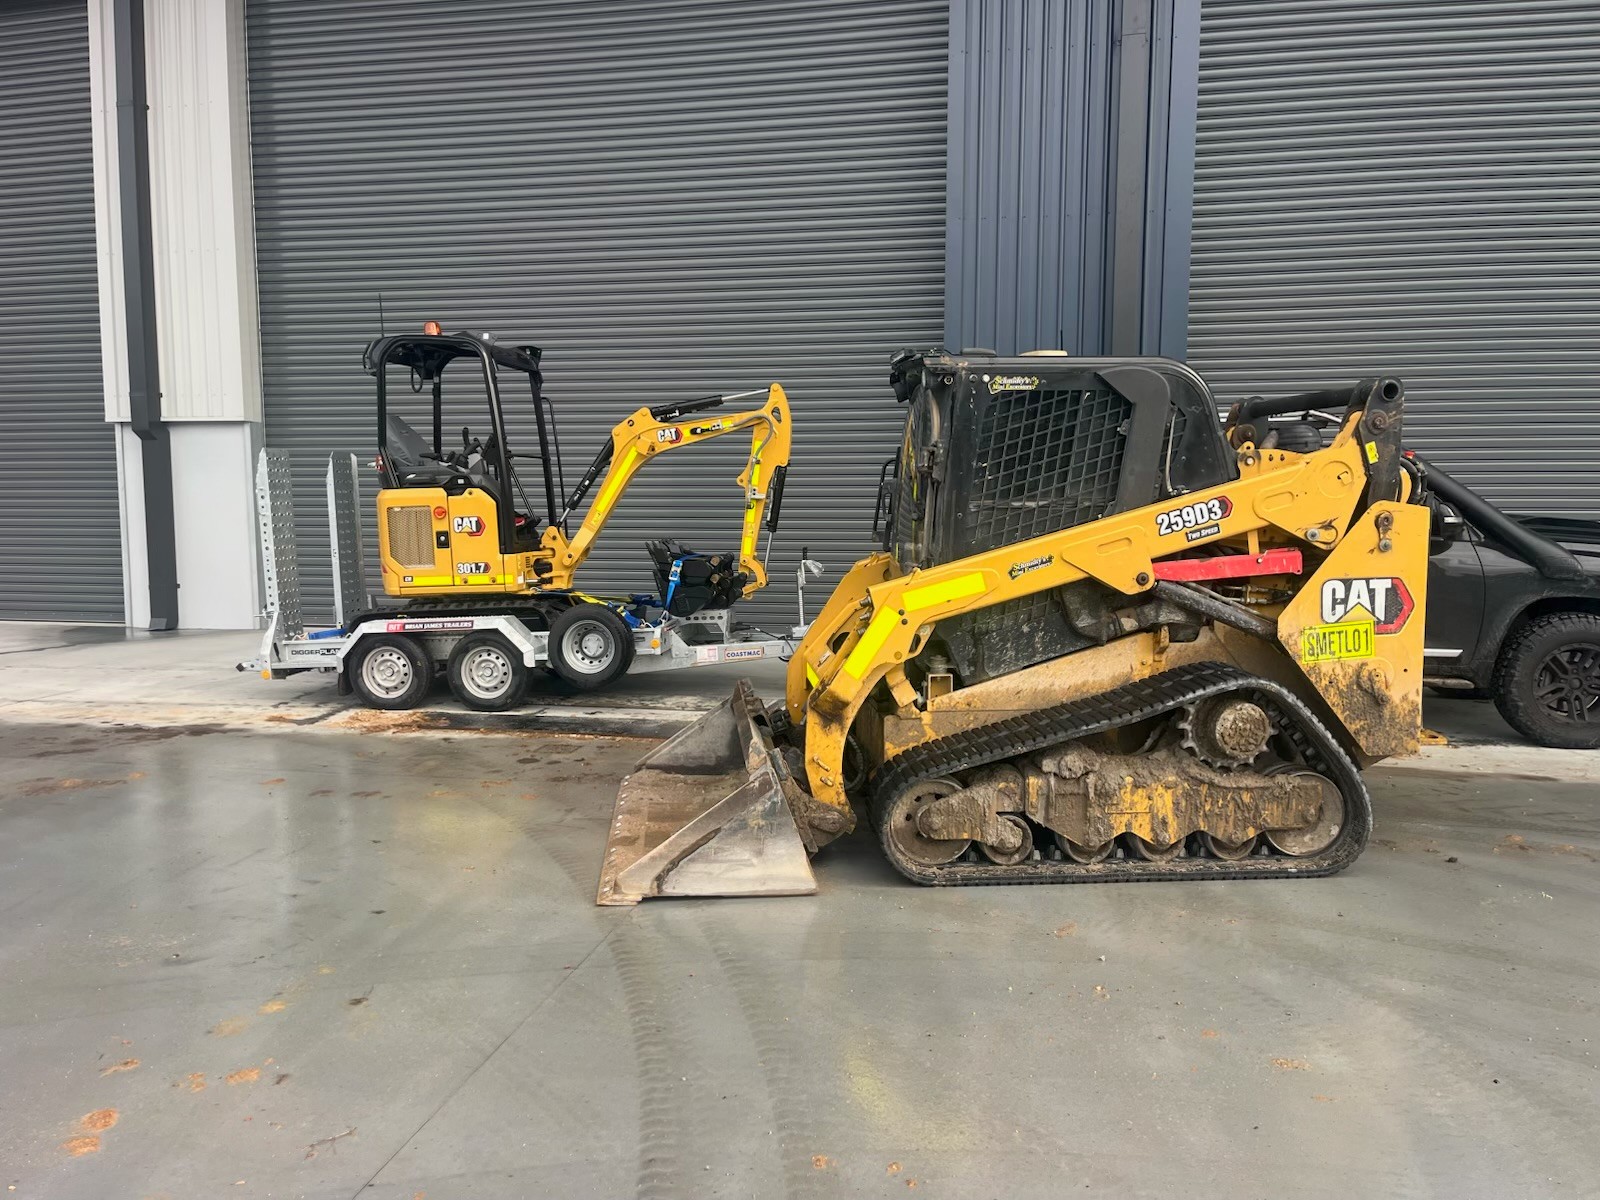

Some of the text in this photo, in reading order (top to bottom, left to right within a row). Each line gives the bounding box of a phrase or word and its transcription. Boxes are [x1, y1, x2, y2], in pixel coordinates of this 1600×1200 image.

[657, 428, 677, 442] CAT
[453, 517, 477, 532] CAT
[1156, 499, 1222, 535] 259D3
[457, 562, 485, 574] 301.7
[1322, 579, 1392, 623] CAT
[1306, 628, 1369, 657] SMETL01
[726, 650, 760, 658] COASTMAC
